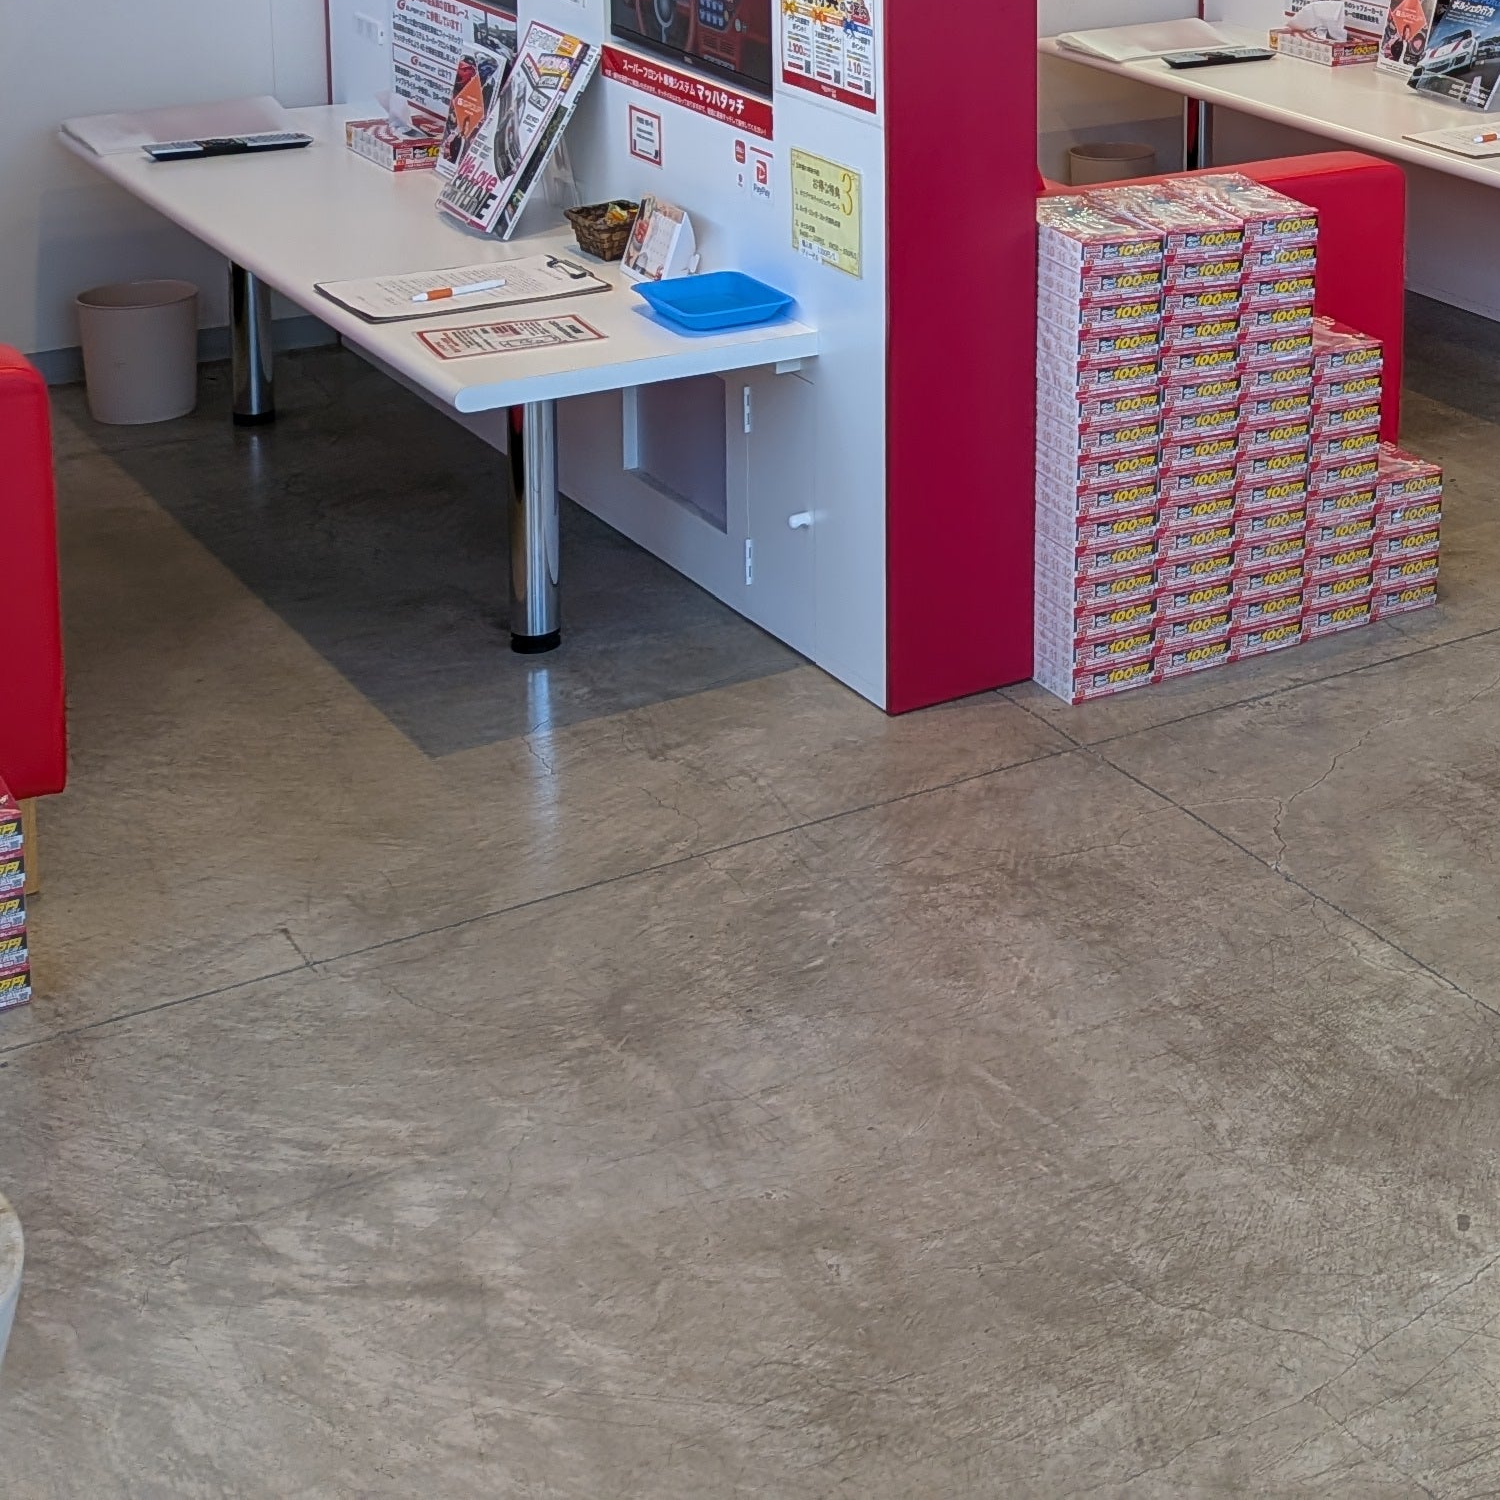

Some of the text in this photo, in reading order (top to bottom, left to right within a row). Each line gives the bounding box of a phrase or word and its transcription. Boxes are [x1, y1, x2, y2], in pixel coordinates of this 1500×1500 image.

[696, 84, 744, 115] マッハタッチ
